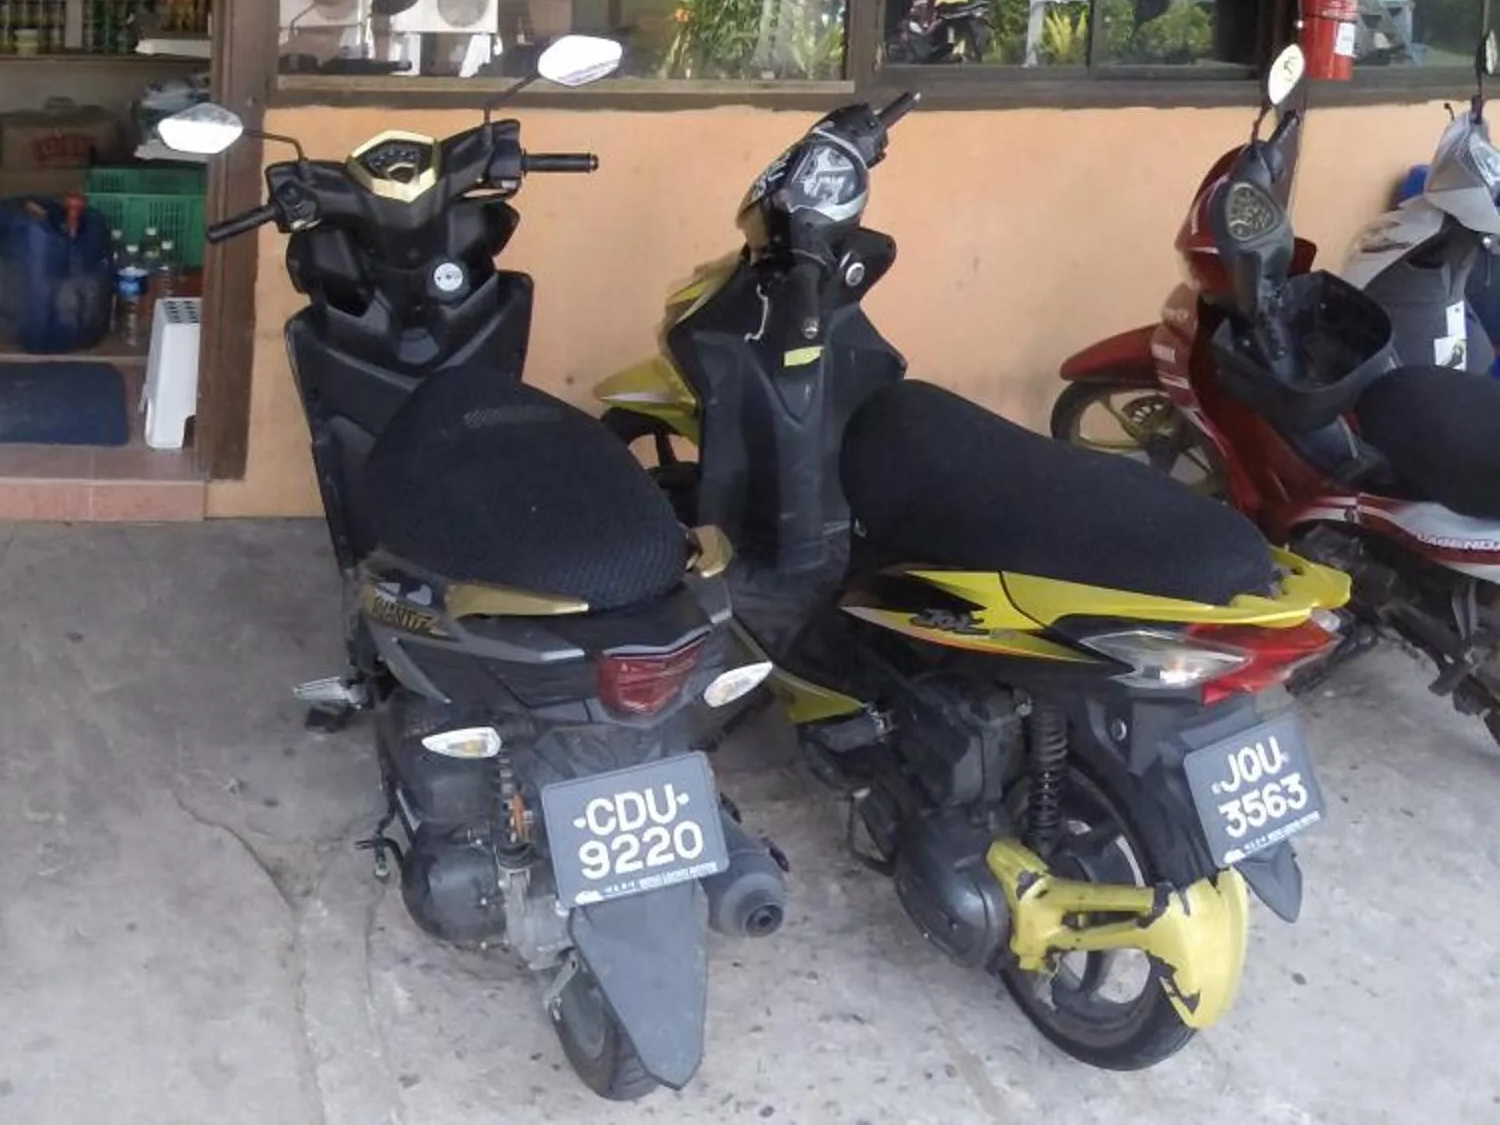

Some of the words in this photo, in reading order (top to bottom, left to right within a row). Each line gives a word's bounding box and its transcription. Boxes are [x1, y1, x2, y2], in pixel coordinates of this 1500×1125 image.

[585, 782, 678, 836] CDU
[1218, 772, 1308, 838] 3563
[578, 819, 705, 881] 9220
